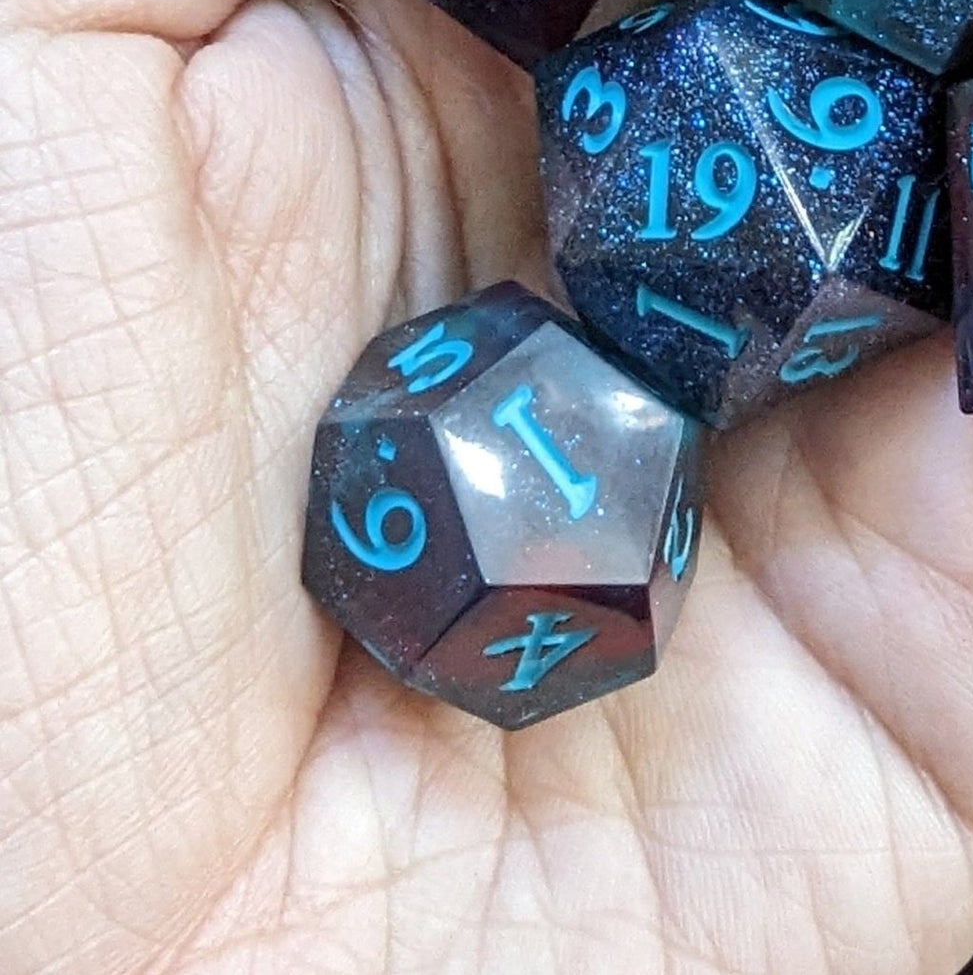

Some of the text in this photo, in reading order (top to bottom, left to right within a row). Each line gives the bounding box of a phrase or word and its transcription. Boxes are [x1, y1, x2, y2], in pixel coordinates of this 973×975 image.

[562, 67, 628, 155] 3
[638, 139, 758, 241] 19
[879, 176, 941, 282] 11
[388, 322, 475, 395] 5
[636, 282, 750, 359] 1
[492, 385, 597, 520] 1
[483, 612, 601, 692] 4
